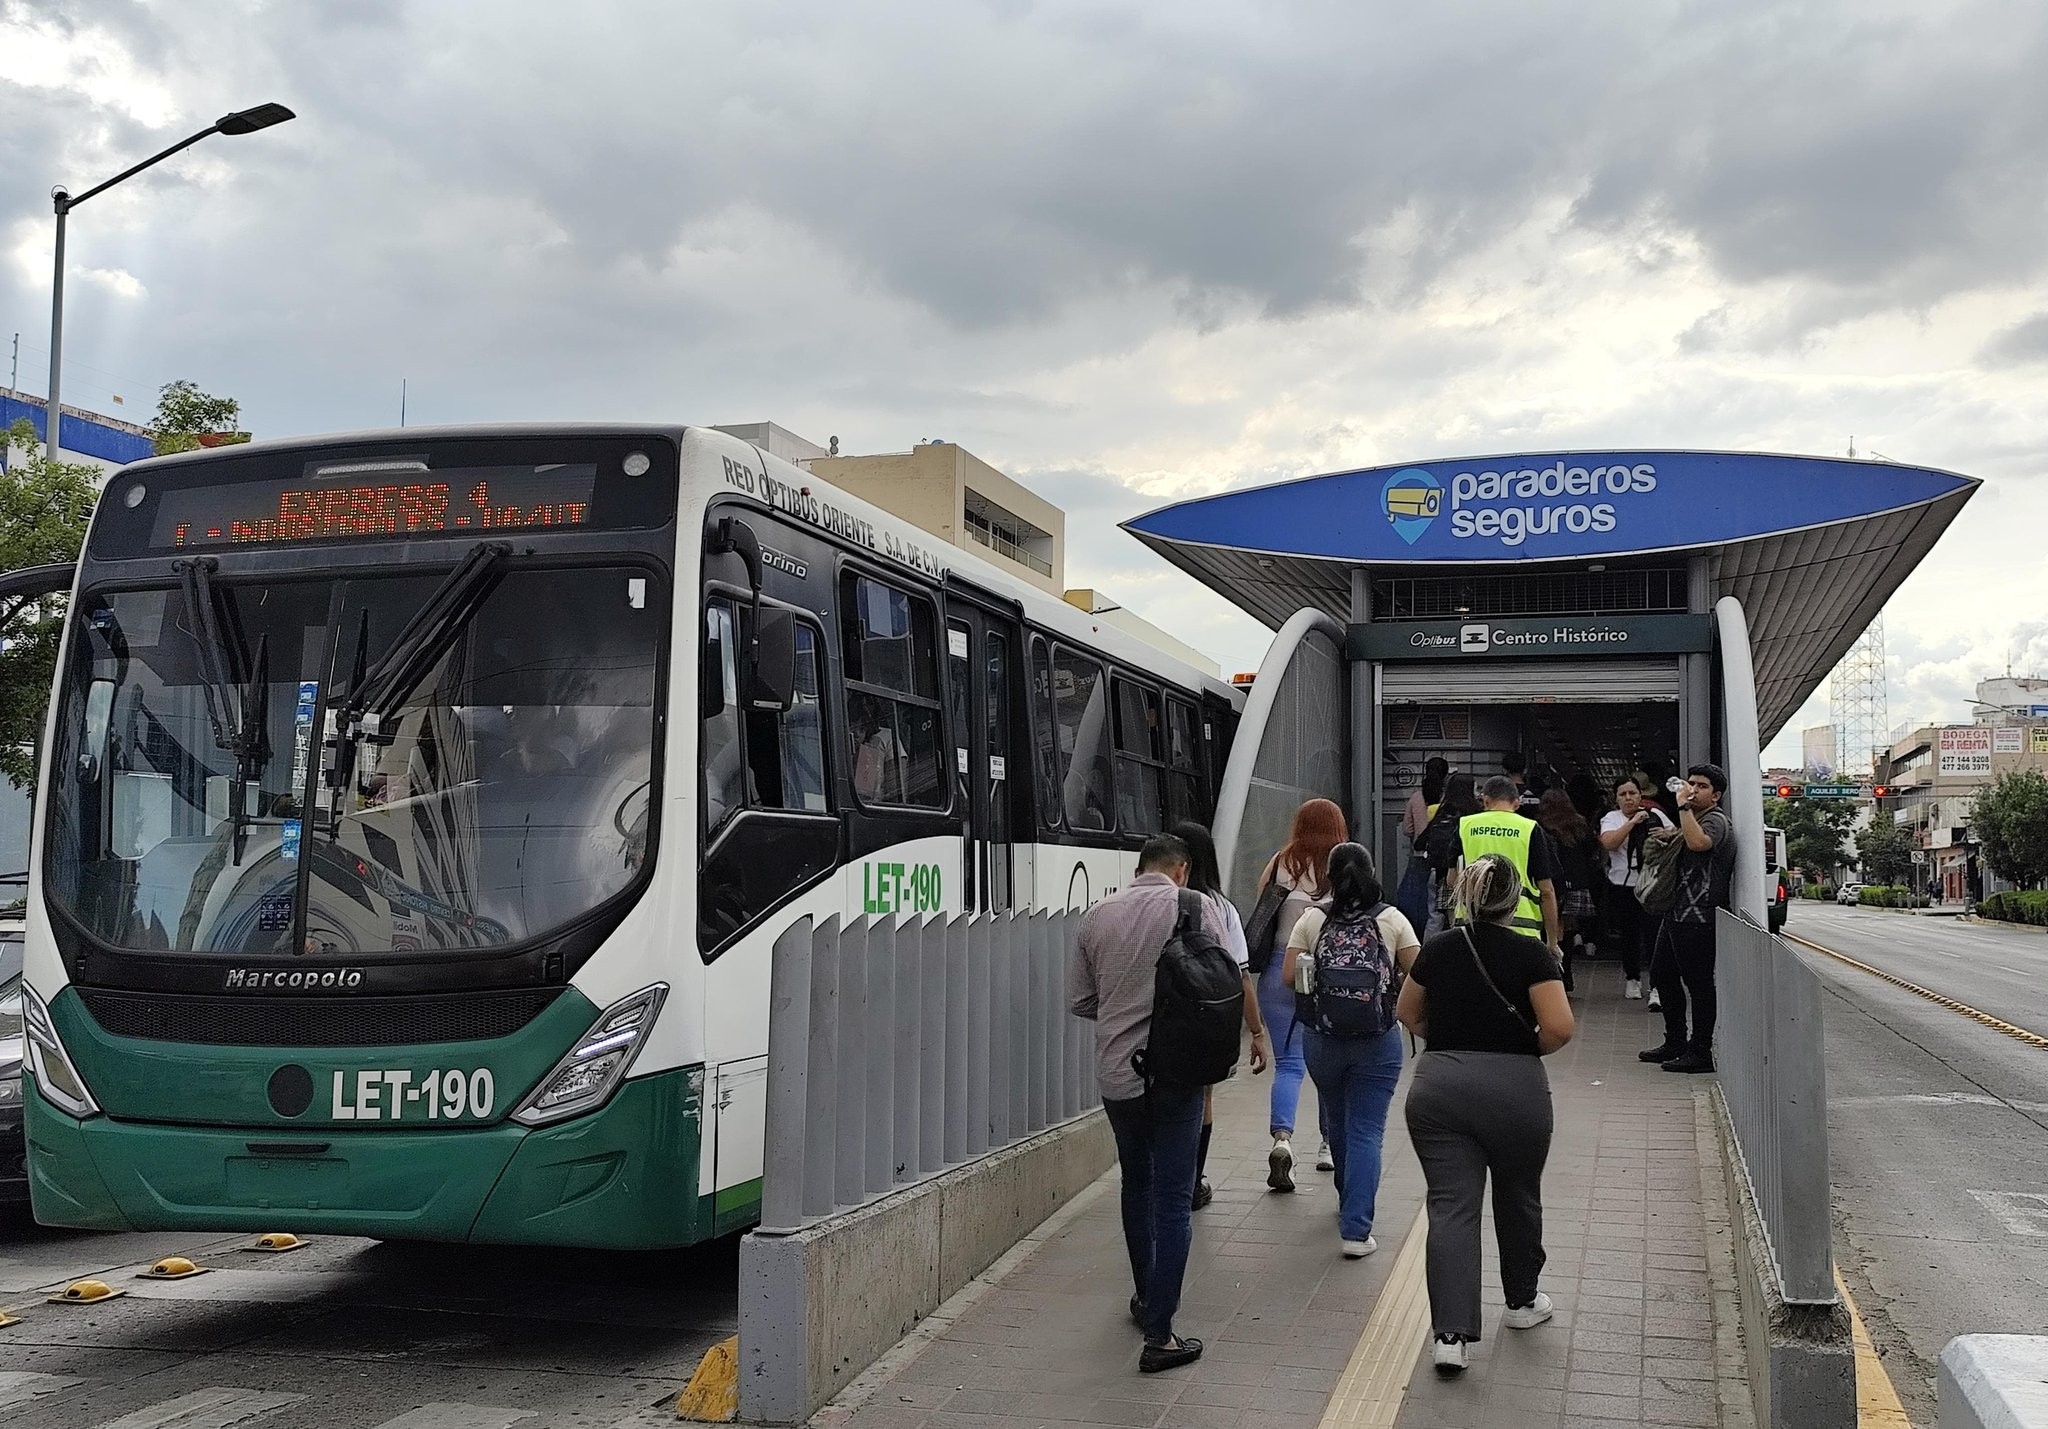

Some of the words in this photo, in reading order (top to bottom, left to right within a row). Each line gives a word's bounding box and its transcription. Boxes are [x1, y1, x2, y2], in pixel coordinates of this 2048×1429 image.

[1451, 461, 1657, 510] paraderos
[281, 483, 450, 521] EXPRESS
[468, 481, 489, 509] 4
[722, 455, 755, 493] RED
[759, 474, 819, 524] OPTIBUS
[822, 503, 875, 549] ORIENTE
[884, 531, 906, 562] S.A.
[907, 542, 922, 569] DE
[923, 550, 943, 579] C.V.
[1451, 503, 1616, 546] seguros
[760, 549, 808, 579] orino
[1410, 631, 1457, 648] Optibus
[1492, 630, 1549, 646] Centro
[1553, 626, 1628, 643] Histórico
[1941, 740, 1955, 750] EN
[1957, 740, 1989, 750] RENTA
[1942, 730, 1989, 740] BODEGA
[1810, 787, 1838, 795] AQUILES
[1470, 826, 1520, 838] INSPECTOR
[864, 862, 942, 914] LET-190
[225, 968, 361, 989] Marcopolo
[332, 1067, 494, 1119] LET-190
